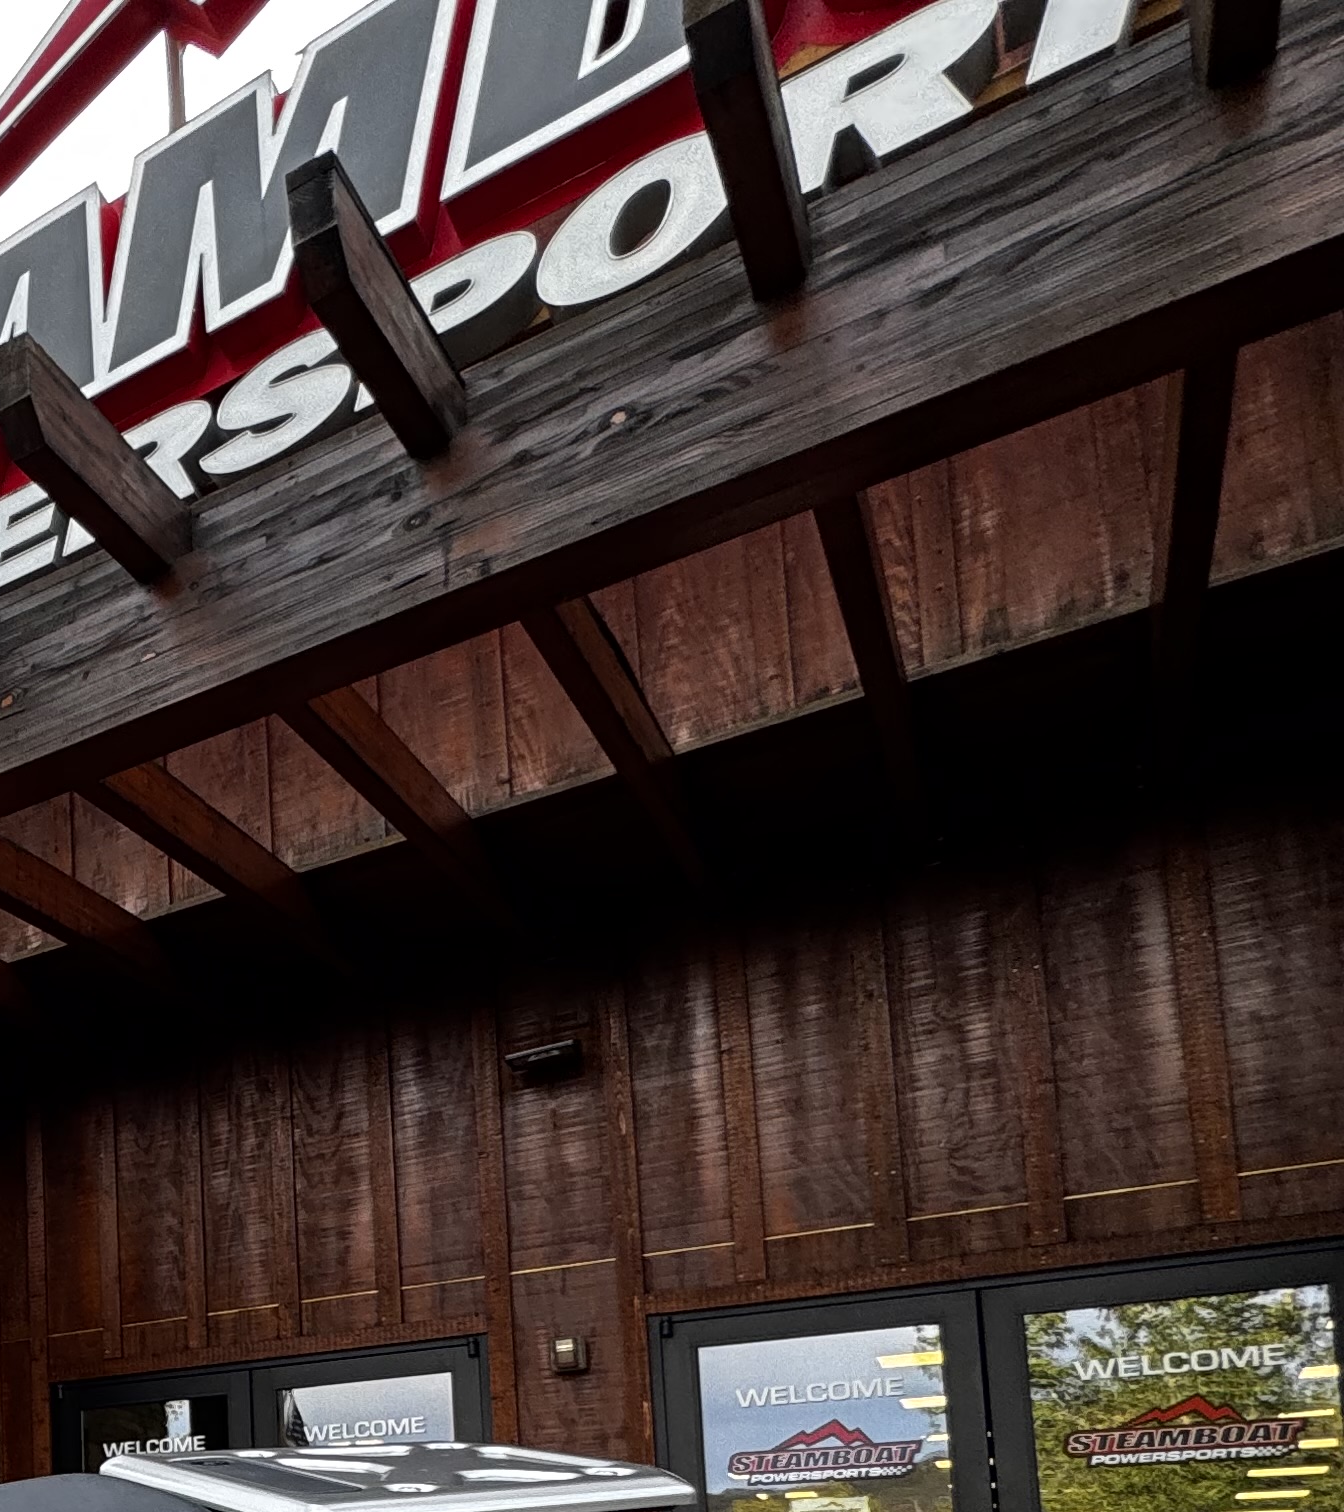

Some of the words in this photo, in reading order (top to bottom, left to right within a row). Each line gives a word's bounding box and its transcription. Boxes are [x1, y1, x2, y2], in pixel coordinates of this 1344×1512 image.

[1072, 1343, 1287, 1381] WELCOME
[735, 1376, 905, 1408] WELCOME
[304, 1416, 426, 1442] WELCOME
[1067, 1420, 1303, 1454] STEAMBOAT
[103, 1435, 206, 1458] WELCOME
[732, 1443, 921, 1474] STEAMBOAT
[1091, 1447, 1258, 1465] POWERSPORTS
[750, 1467, 882, 1484] POWERSPORTS
